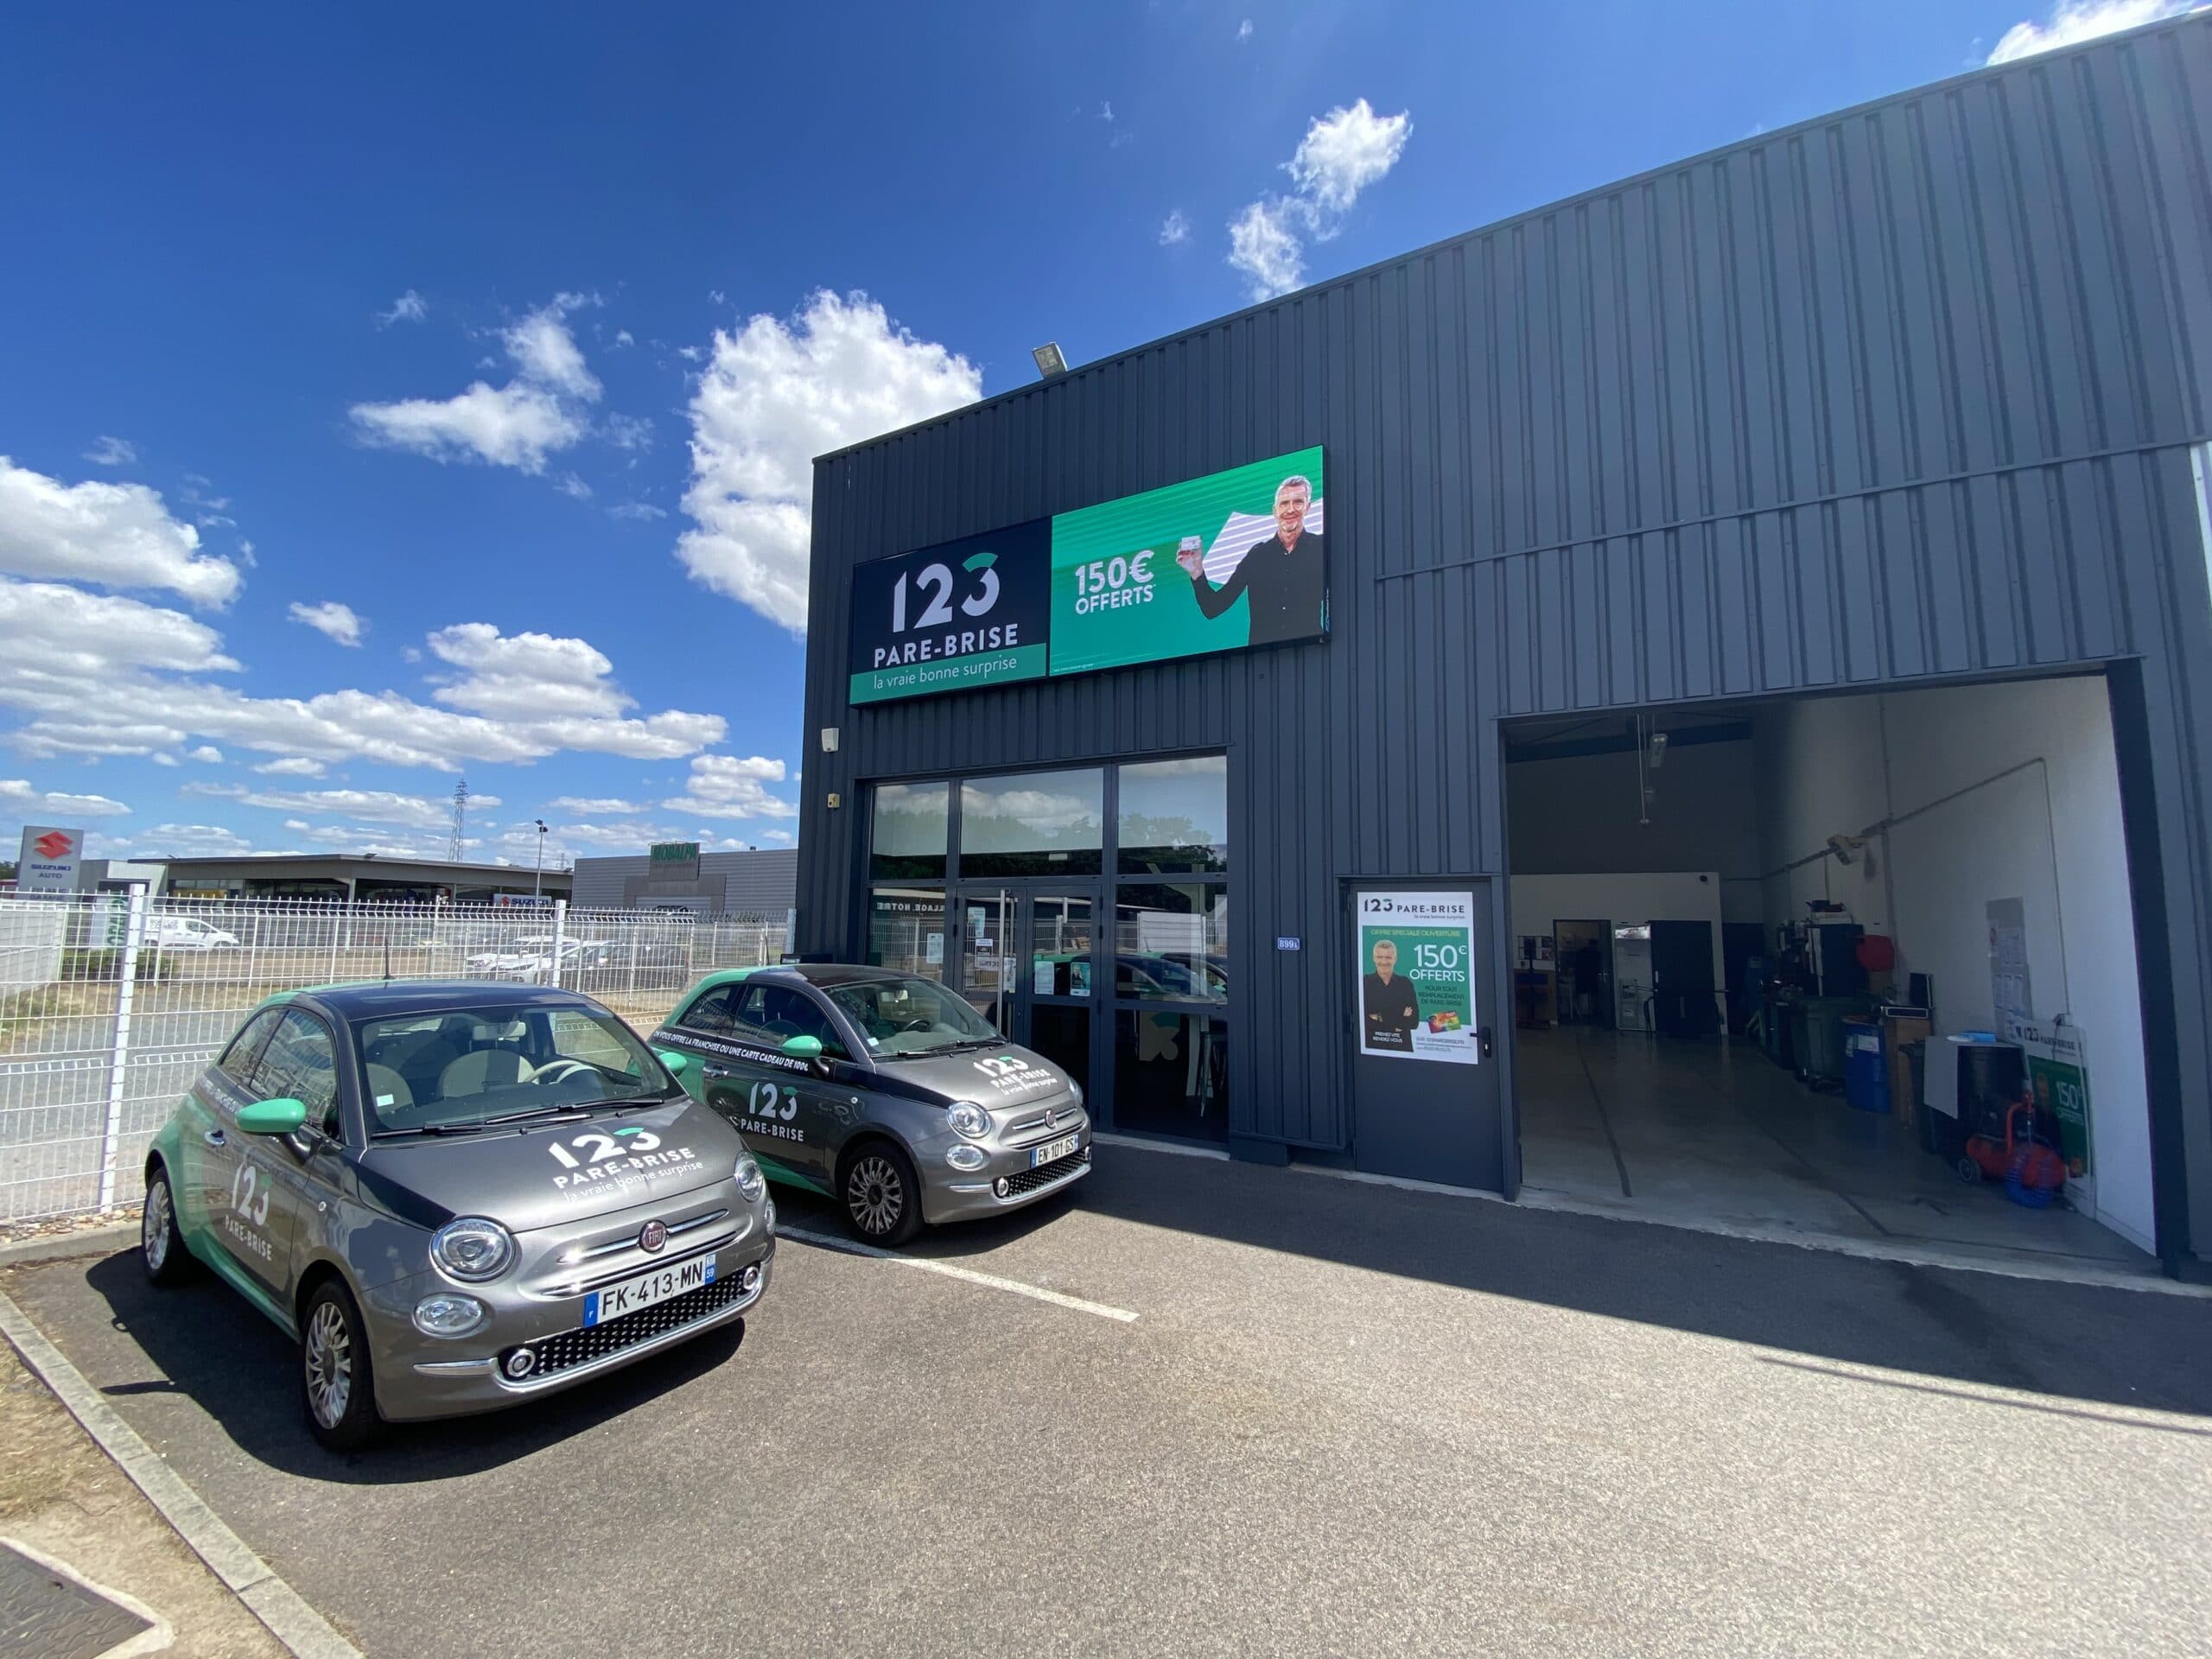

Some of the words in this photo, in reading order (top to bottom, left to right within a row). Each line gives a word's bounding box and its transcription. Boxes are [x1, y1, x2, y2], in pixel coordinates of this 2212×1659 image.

[893, 552, 1000, 633] 123
[1075, 550, 1155, 596] 150€
[874, 623, 1019, 669] PARE-BRISE
[874, 674, 884, 690] la
[887, 670, 916, 688] vraie
[919, 667, 960, 683] bonne
[963, 654, 1017, 679] surprise
[1363, 898, 1393, 912] 123
[1396, 905, 1465, 913] PARE-BRISE
[1409, 969, 1465, 982] OFFERTS
[1414, 944, 1467, 968] 150€
[671, 1033, 686, 1045] OFFRE
[691, 1039, 721, 1052] FRANCHISE
[720, 1044, 729, 1053] OU
[728, 1046, 742, 1056] UNE
[741, 1049, 760, 1060] CARTE
[759, 1053, 785, 1065] CADEAU
[784, 1058, 795, 1068] DE
[973, 1056, 1028, 1077] 123
[990, 1069, 1051, 1088] PARE-BRISE
[749, 1082, 798, 1121] 123
[549, 1127, 661, 1168] 123
[741, 1118, 804, 1142] PARE-BRISE
[553, 1147, 695, 1189] PARE-BRISE
[563, 1192, 576, 1203] la
[581, 1181, 614, 1197] vraie
[614, 1172, 656, 1188] bonne
[658, 1161, 704, 1177] surprise
[232, 1160, 273, 1225] 123
[224, 1214, 273, 1262] PARE-BRISE
[648, 1228, 662, 1245] FIAT
[602, 1261, 703, 1316] FK-413-MN
